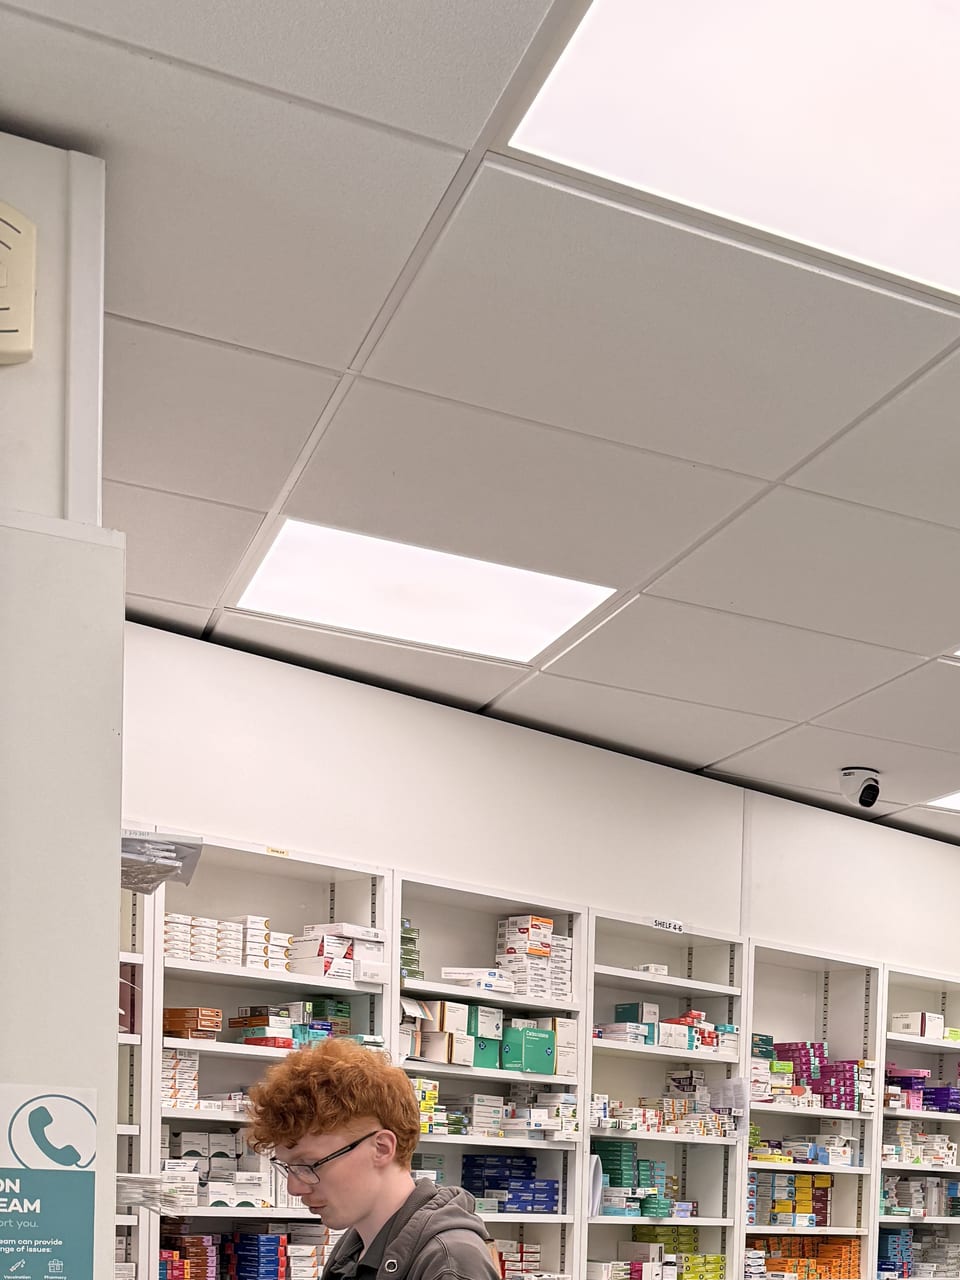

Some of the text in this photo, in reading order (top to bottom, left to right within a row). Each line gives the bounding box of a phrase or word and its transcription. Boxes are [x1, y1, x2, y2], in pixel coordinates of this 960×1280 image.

[654, 920, 671, 929] SHELF
[16, 1221, 39, 1229] you.
[34, 1238, 63, 1246] provide
